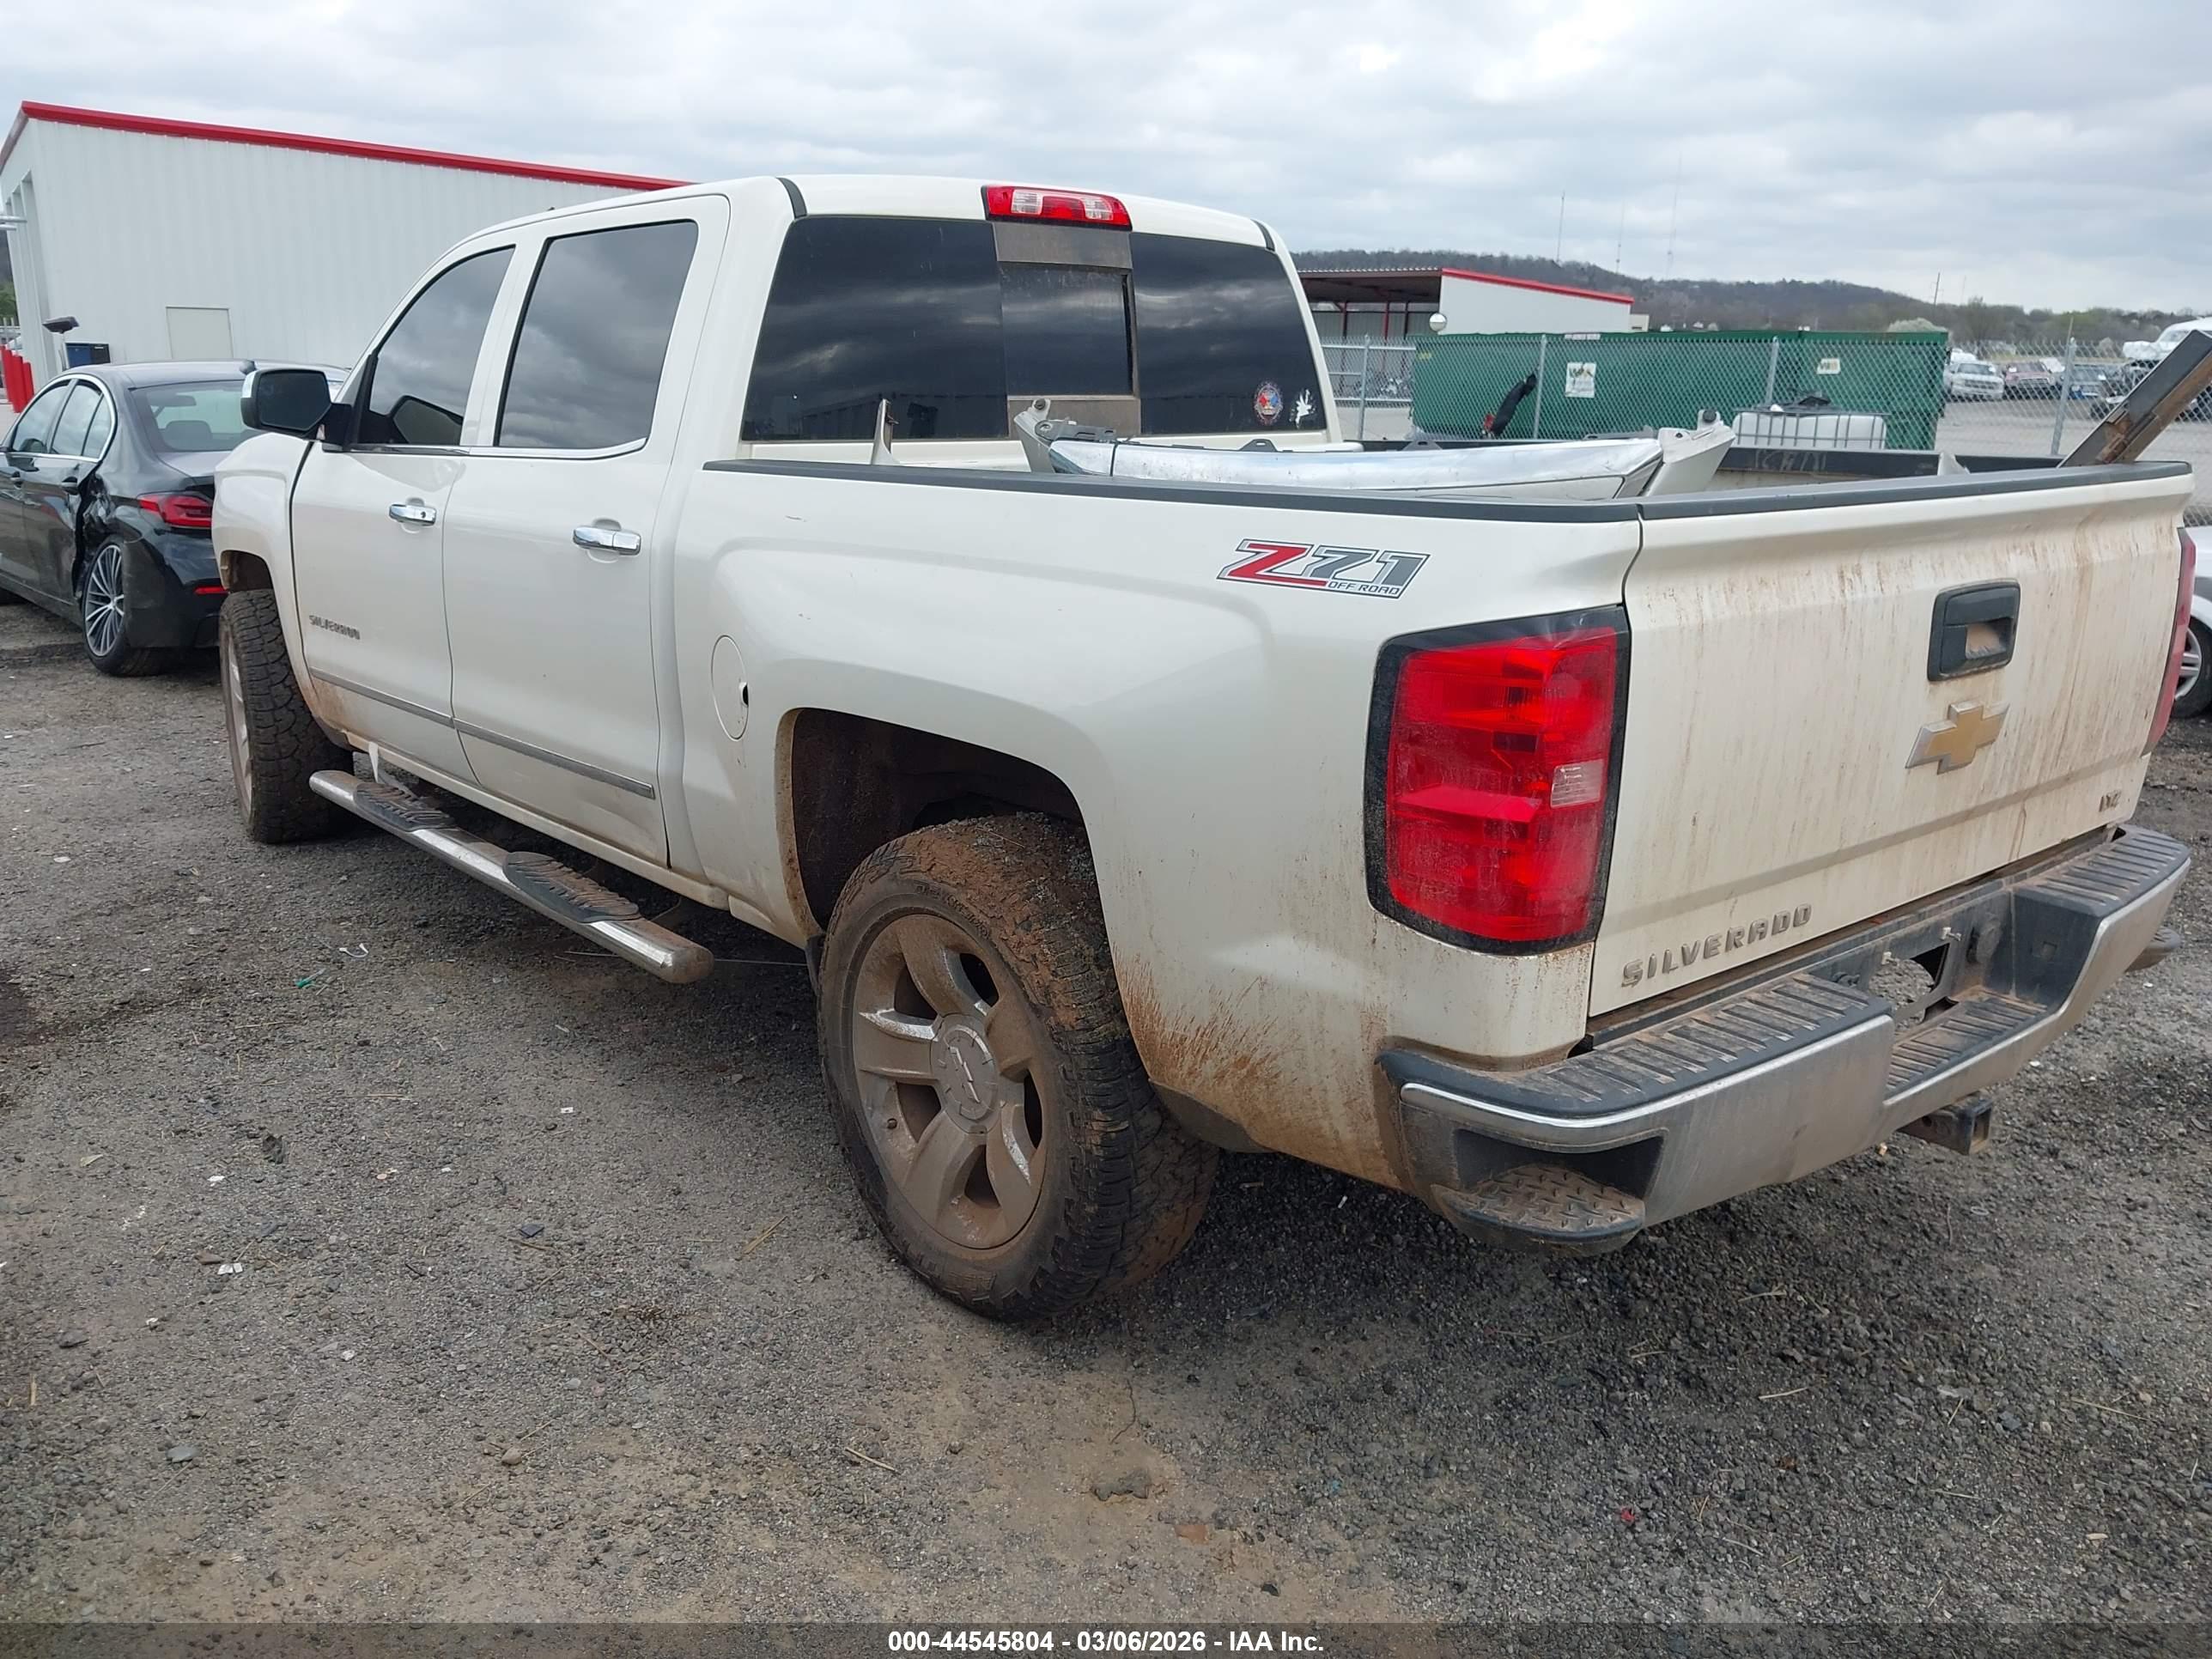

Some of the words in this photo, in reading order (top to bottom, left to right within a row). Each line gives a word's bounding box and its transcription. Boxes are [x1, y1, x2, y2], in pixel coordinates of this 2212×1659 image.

[1218, 539, 1430, 599] Z71
[1328, 581, 1355, 591] OFF
[1358, 585, 1399, 595] ROAD
[1621, 902, 1812, 988] SILVERADO
